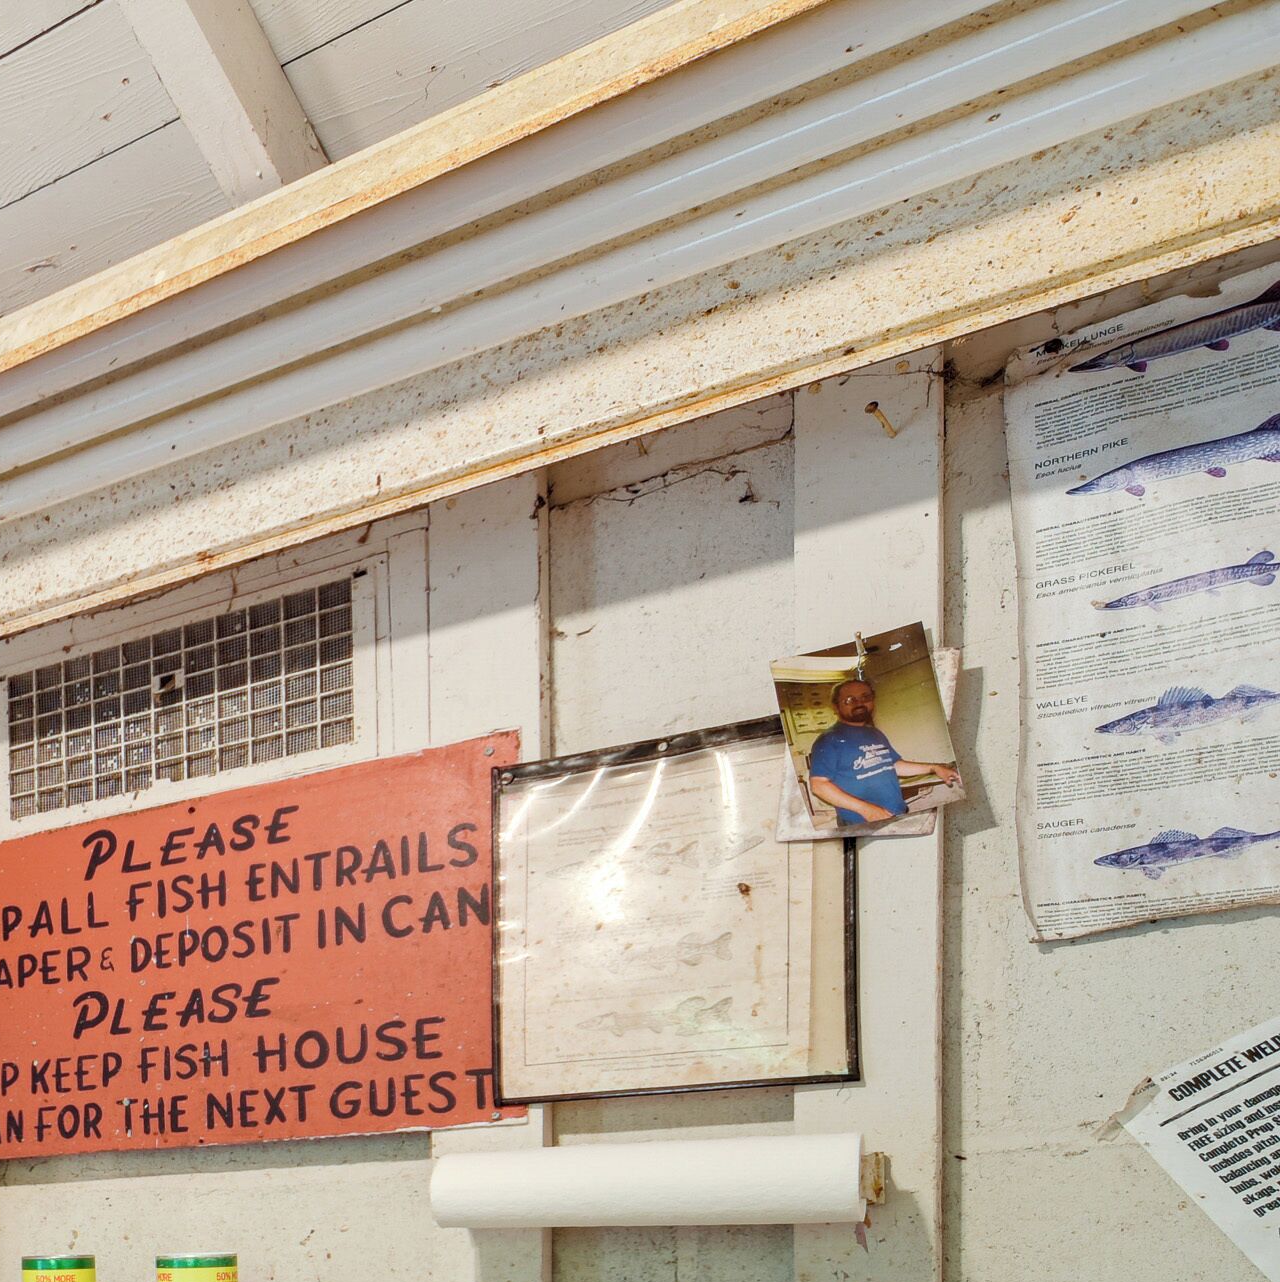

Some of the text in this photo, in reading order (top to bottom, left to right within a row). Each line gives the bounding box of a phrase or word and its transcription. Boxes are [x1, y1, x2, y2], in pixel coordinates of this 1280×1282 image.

[1036, 323, 1124, 357] MKELLUNGE
[1034, 438, 1129, 470] NORTHERN PIKE
[1035, 463, 1082, 479] Esox lucius
[1036, 562, 1136, 589] GRASS PICKEREL
[1058, 581, 1106, 595] americanus
[1037, 695, 1088, 710] WALLEYE
[1037, 696, 1156, 720] Stizostedion vitreum vitreum
[1037, 818, 1084, 830] SAUGER
[1037, 823, 1136, 840] Stizostedion canadense
[83, 805, 299, 881] PLEASE
[30, 892, 108, 936] ALL
[126, 872, 227, 922] FISH
[245, 822, 479, 901] ENTRAILS
[100, 947, 115, 972] &
[130, 913, 299, 973] DEPOSIT
[318, 902, 366, 949] IN
[382, 884, 490, 938] CAN
[72, 977, 281, 1039] PLEASE
[33, 1051, 122, 1094] KEEP
[138, 1039, 230, 1083] FISH
[253, 1017, 446, 1072] HOUSE
[1168, 1056, 1247, 1102] COMPLETE
[36, 1104, 103, 1141] FOR
[122, 1096, 189, 1137] THE
[207, 1085, 315, 1129] NEXT
[330, 1068, 495, 1119] GUEST
[1177, 1123, 1208, 1141] Bring
[1204, 1115, 1218, 1127] in
[1217, 1104, 1242, 1123] your
[1188, 1133, 1214, 1151] FREE
[1213, 1119, 1246, 1140] sizing
[1244, 1109, 1265, 1125] and
[1199, 1136, 1248, 1162] Complete
[1246, 1121, 1275, 1140] Prop
[1209, 1149, 1254, 1173] includes
[1219, 1156, 1271, 1183] balancing
[36, 1274, 76, 1282] 50% MORE
